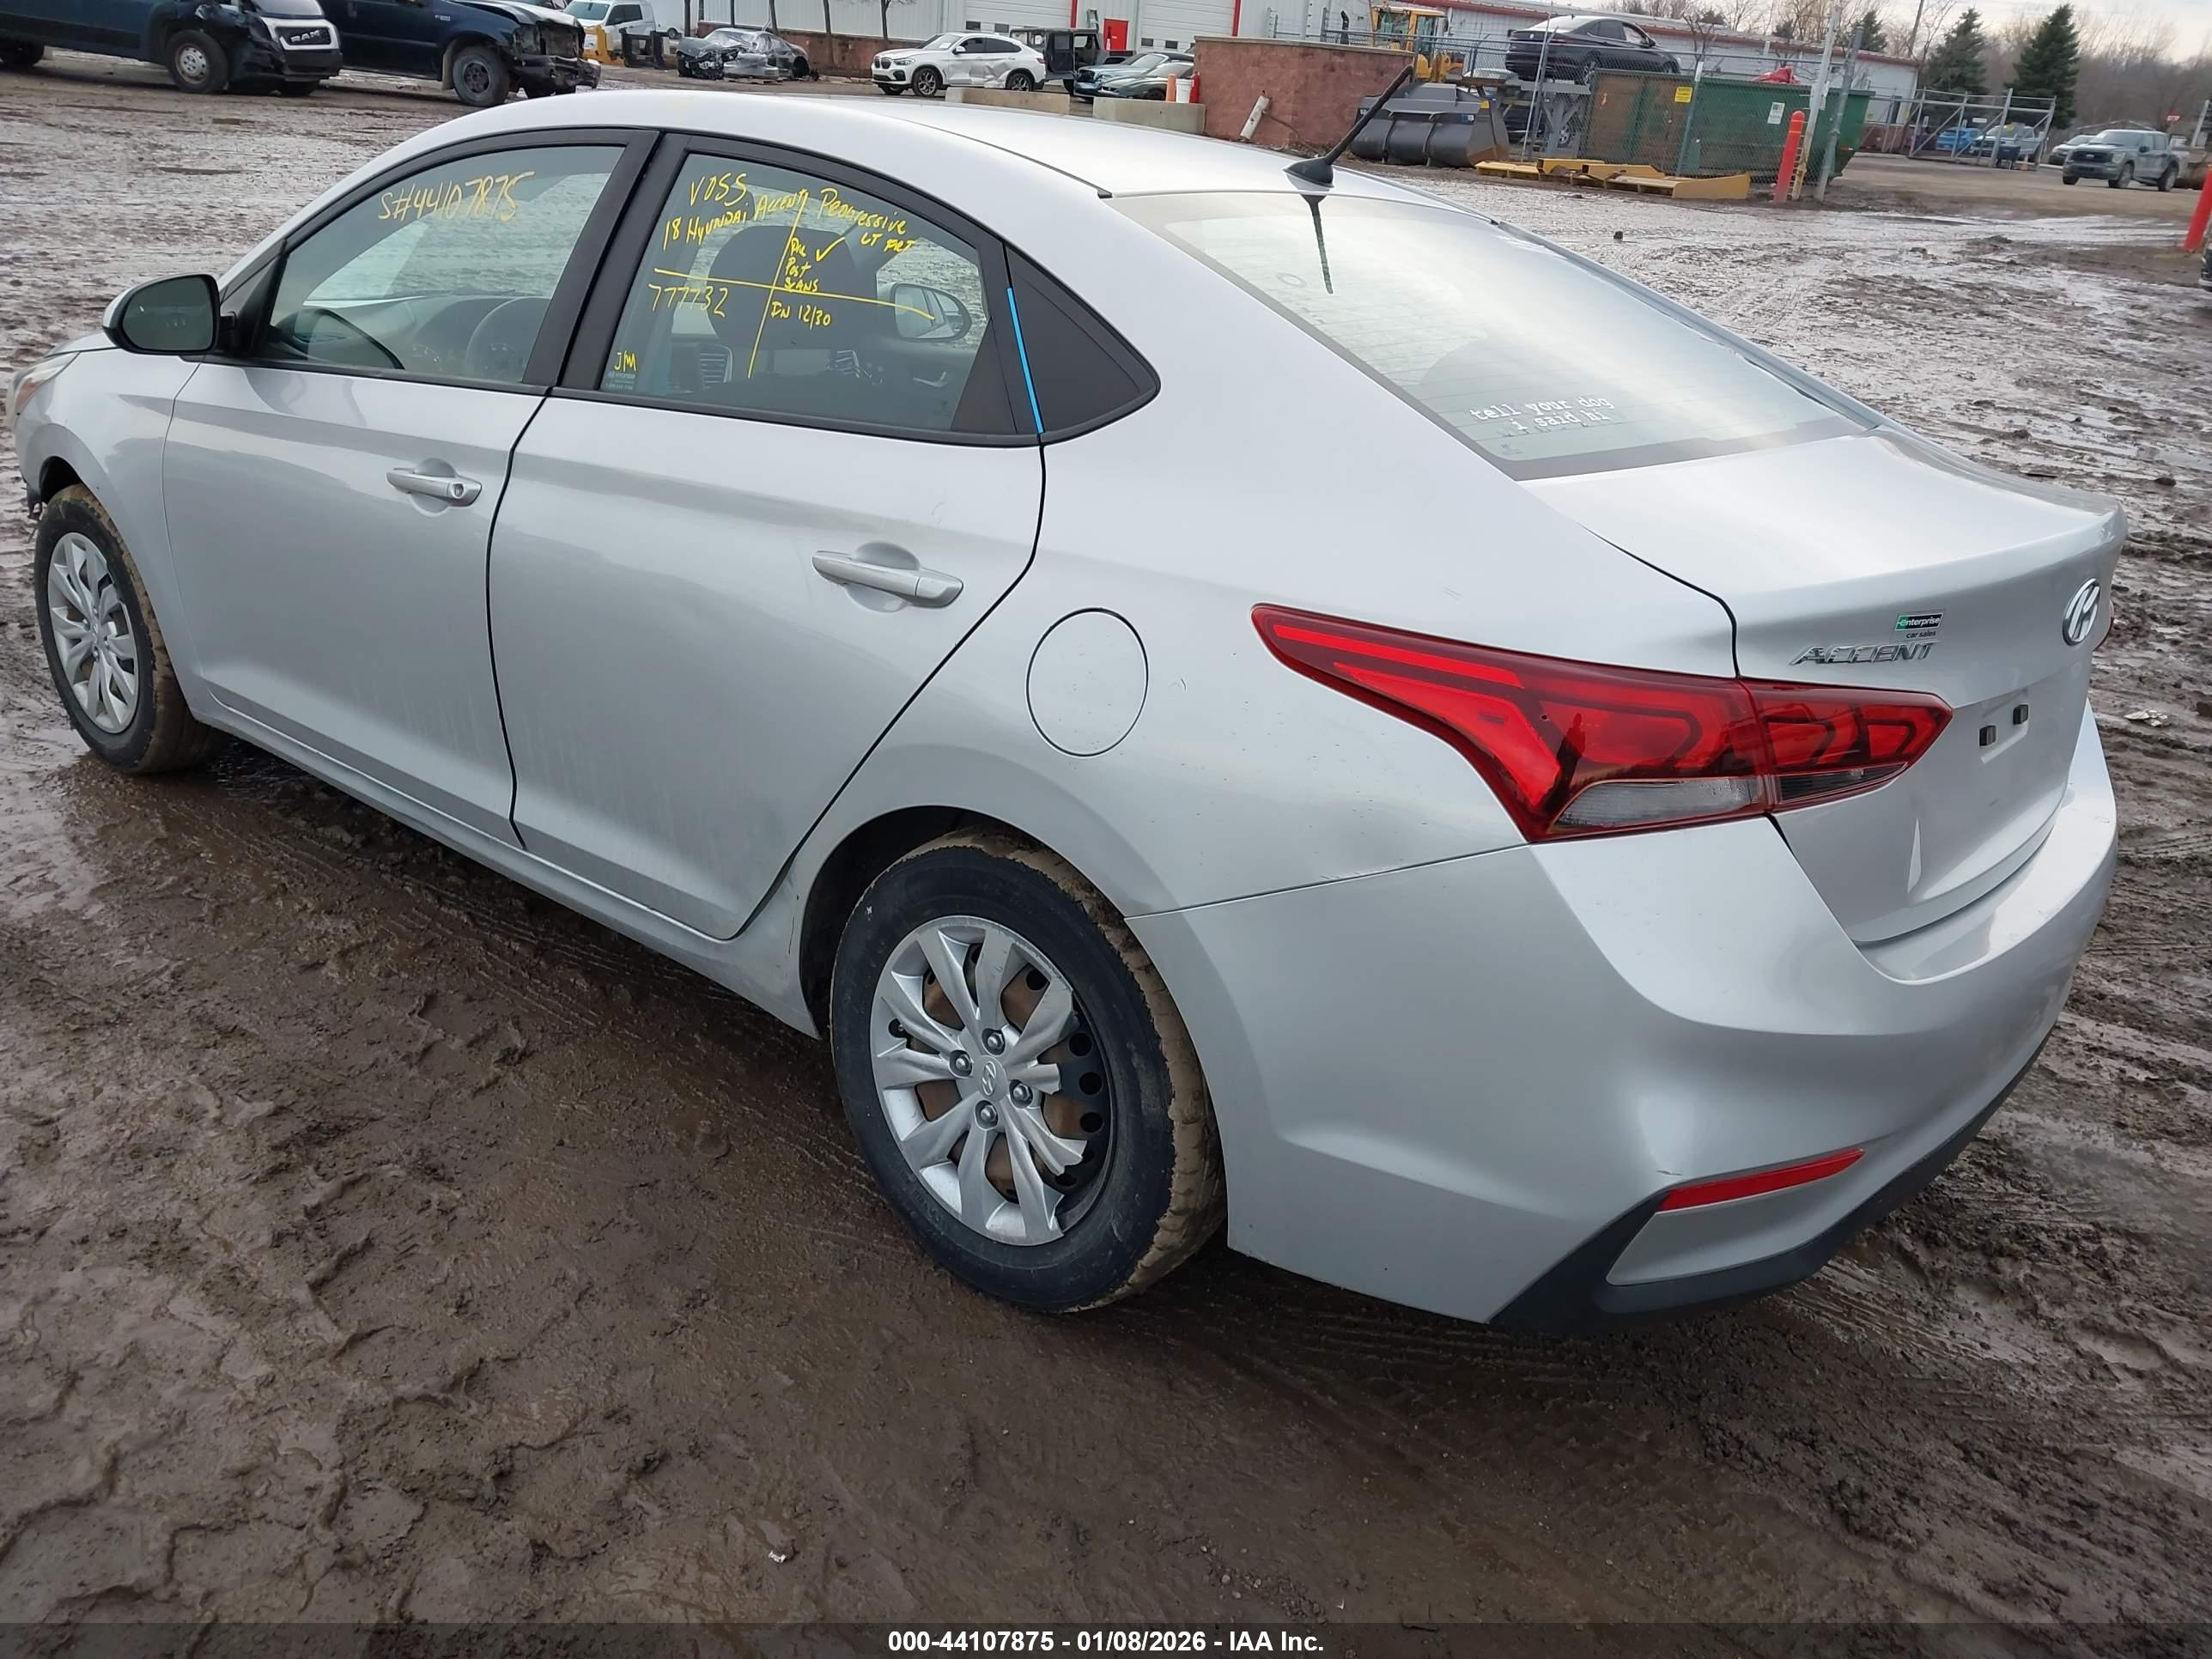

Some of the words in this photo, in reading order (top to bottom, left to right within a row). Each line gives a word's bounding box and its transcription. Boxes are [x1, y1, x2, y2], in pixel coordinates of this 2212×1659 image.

[290, 29, 320, 42] RAM
[690, 172, 747, 206] VOSS
[663, 216, 682, 251] 18
[647, 283, 728, 318] 777732
[798, 304, 831, 331] 12/30
[1469, 404, 1522, 420] tell
[1525, 399, 1573, 416] your
[1577, 396, 1615, 410] dog
[1510, 417, 1528, 430] i
[1534, 411, 1582, 428] said
[1579, 409, 1610, 422] hi
[1899, 617, 1941, 628] enterprise
[1918, 629, 1936, 638] sales
[1789, 641, 1942, 666] ACCENT
